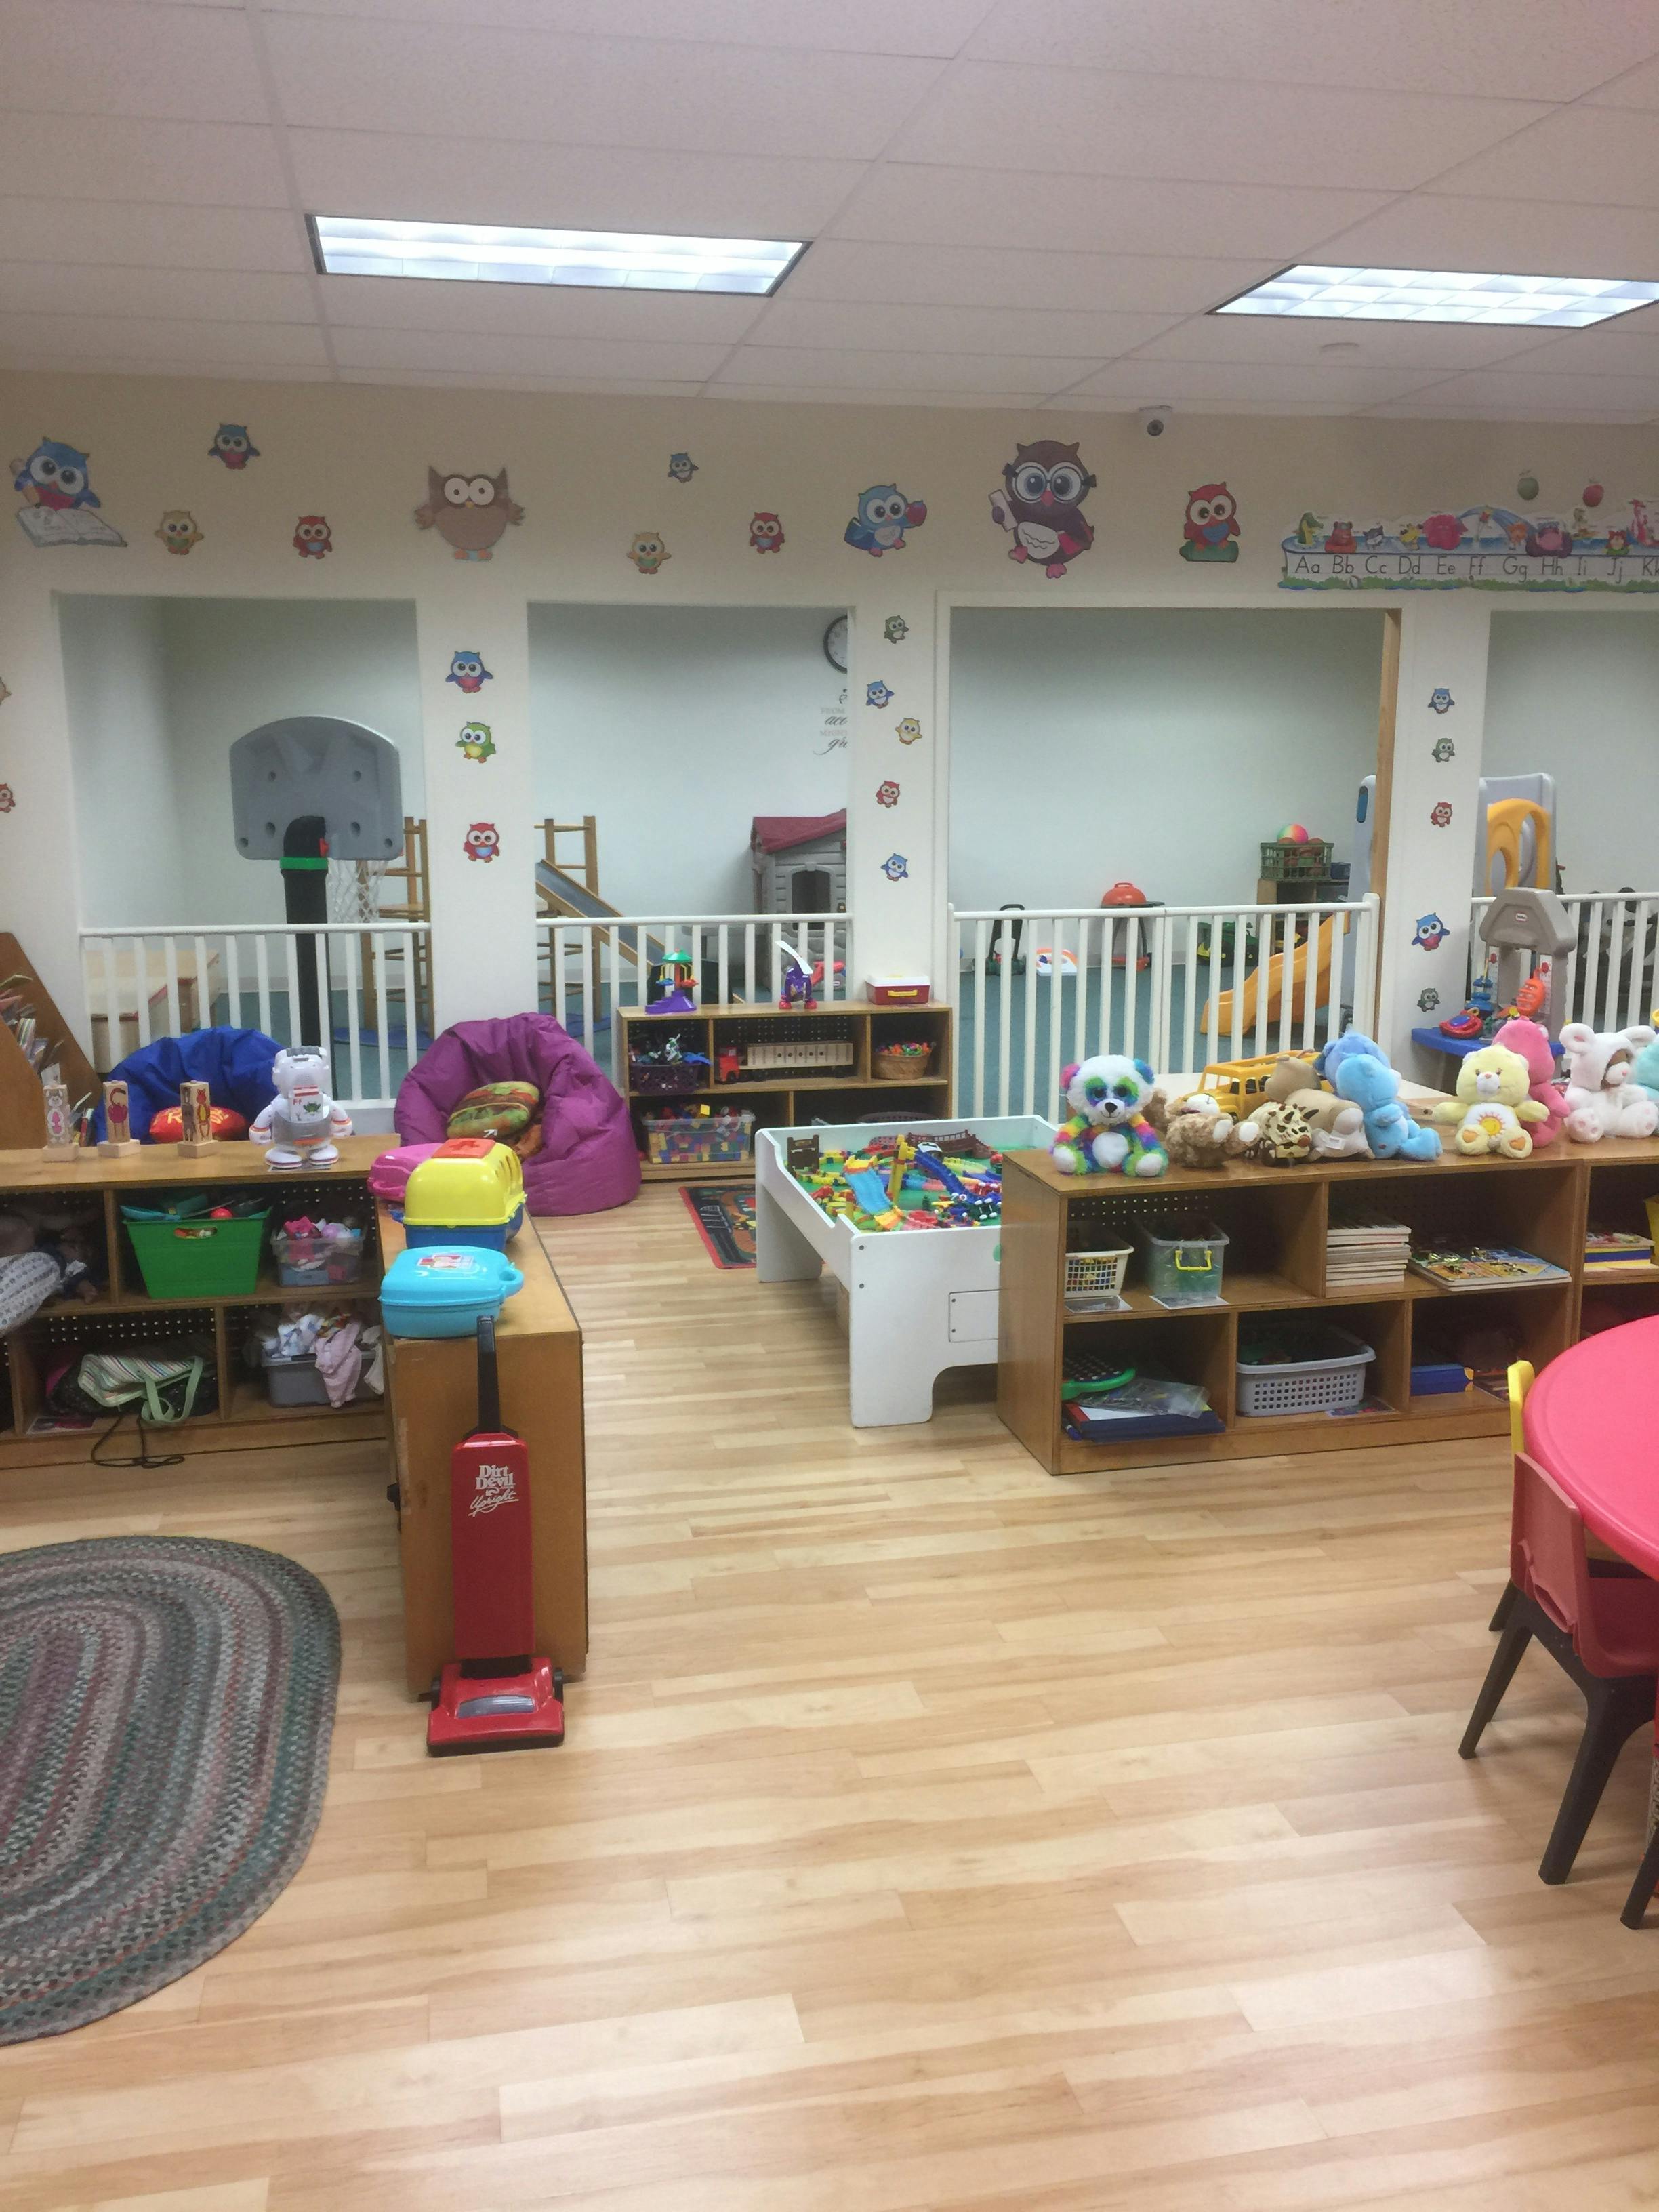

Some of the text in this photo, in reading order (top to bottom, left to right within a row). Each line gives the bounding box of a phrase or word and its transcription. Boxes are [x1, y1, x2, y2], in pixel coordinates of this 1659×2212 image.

[1295, 555, 1321, 575] Aa
[1332, 555, 1355, 575] Bb
[1365, 555, 1387, 575] Cc
[1398, 555, 1421, 575] Dd
[1437, 556, 1456, 575] Ee
[1469, 556, 1486, 576] Ff
[1502, 556, 1528, 583] Gg
[1542, 556, 1563, 576] Hh
[1578, 556, 1587, 576] Ii
[1607, 557, 1623, 584] Jj
[476, 1473, 516, 1490] Devil
[478, 1464, 509, 1477] Dirt
[468, 1489, 520, 1517] Upright
